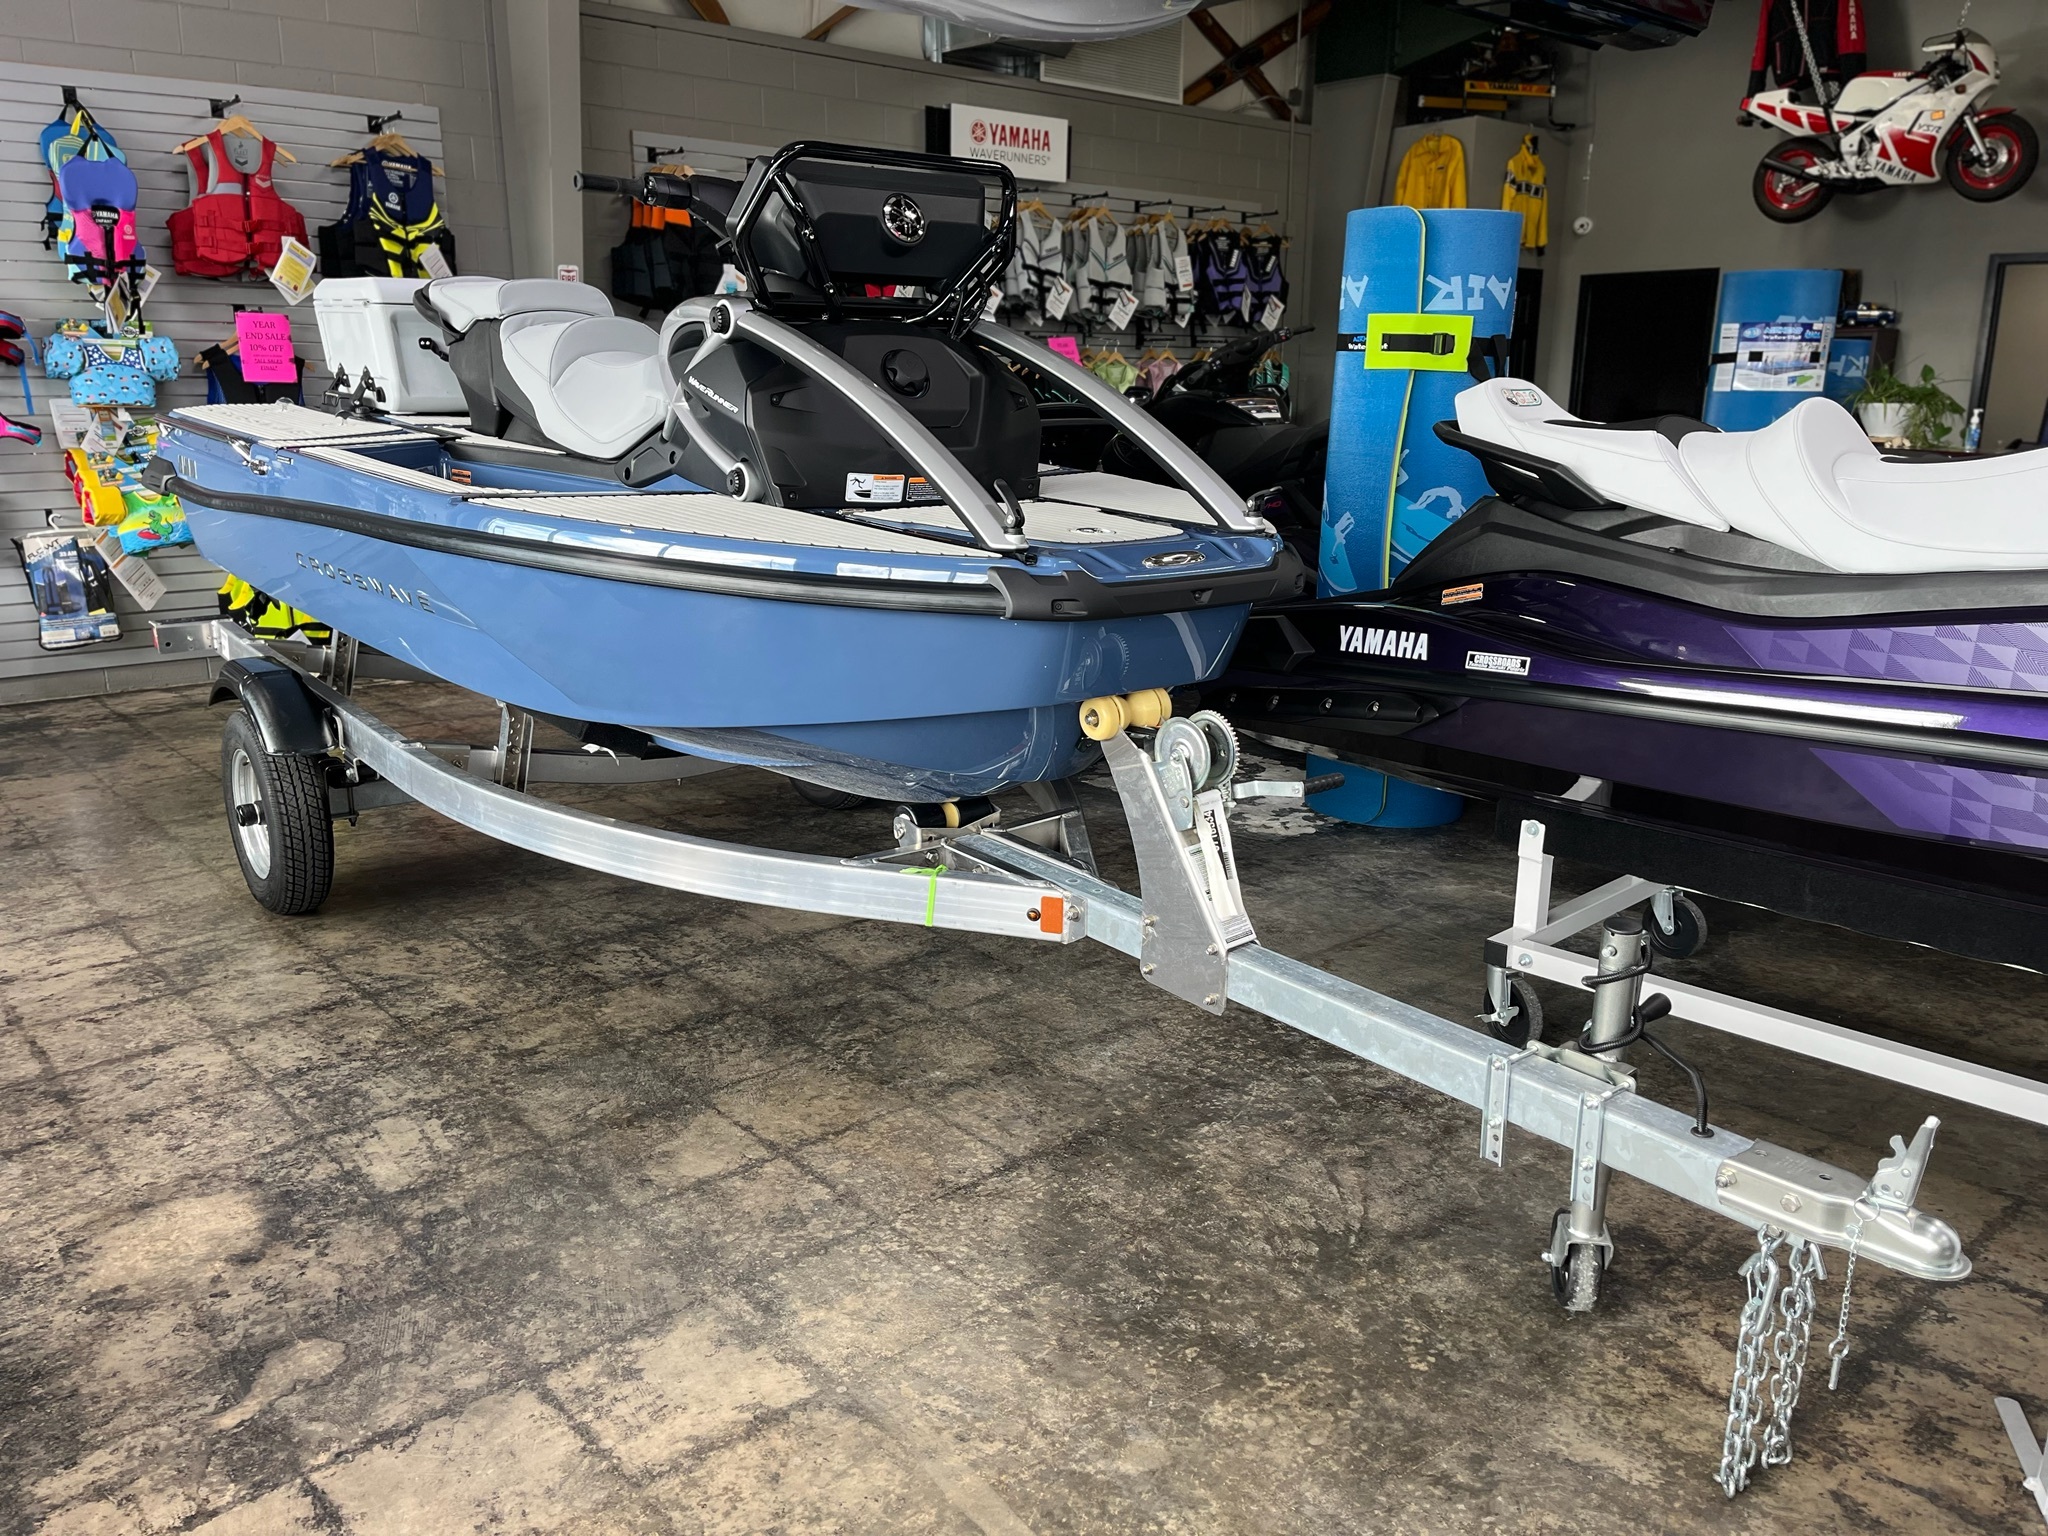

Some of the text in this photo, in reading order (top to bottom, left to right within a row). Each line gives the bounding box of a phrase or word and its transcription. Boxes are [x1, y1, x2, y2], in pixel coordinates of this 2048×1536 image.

[1917, 123, 1942, 133] YSR
[989, 122, 1051, 152] YAMAHA
[969, 146, 1047, 166] WAVERUNNERS
[1874, 159, 1917, 183] YAMAHA
[95, 210, 119, 219] YAMAHA
[252, 320, 276, 329] YEAR
[245, 332, 287, 341] END SALE
[250, 343, 285, 352] 10% OFF
[688, 375, 740, 414] WAVERUNNER
[296, 552, 436, 614] CROSSWAVE
[1339, 624, 1429, 661] YAMAHA
[1474, 654, 1522, 669] CROSSROADS
